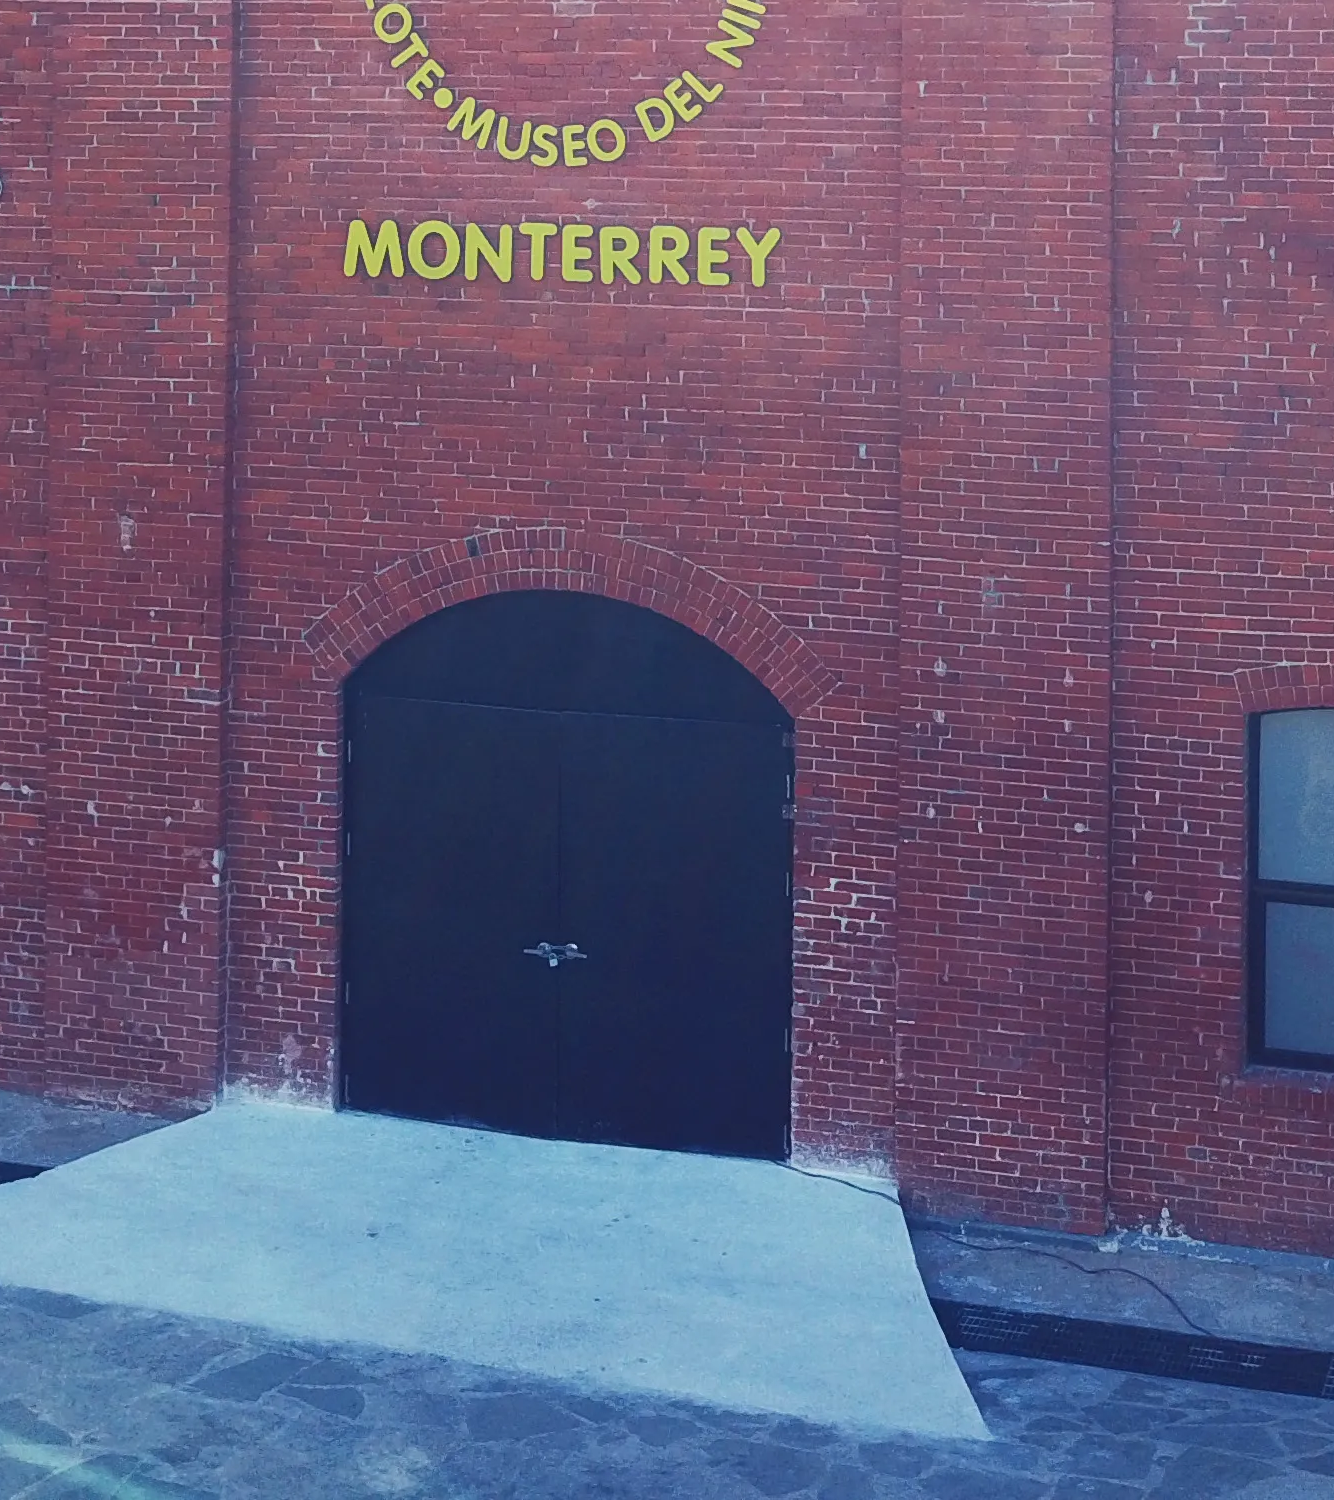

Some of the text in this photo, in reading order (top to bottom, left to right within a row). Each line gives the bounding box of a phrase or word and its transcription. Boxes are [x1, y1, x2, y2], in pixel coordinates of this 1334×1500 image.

[447, 97, 627, 167] MUSEO
[636, 70, 724, 143] DEL
[343, 219, 781, 287] MONTERREY
